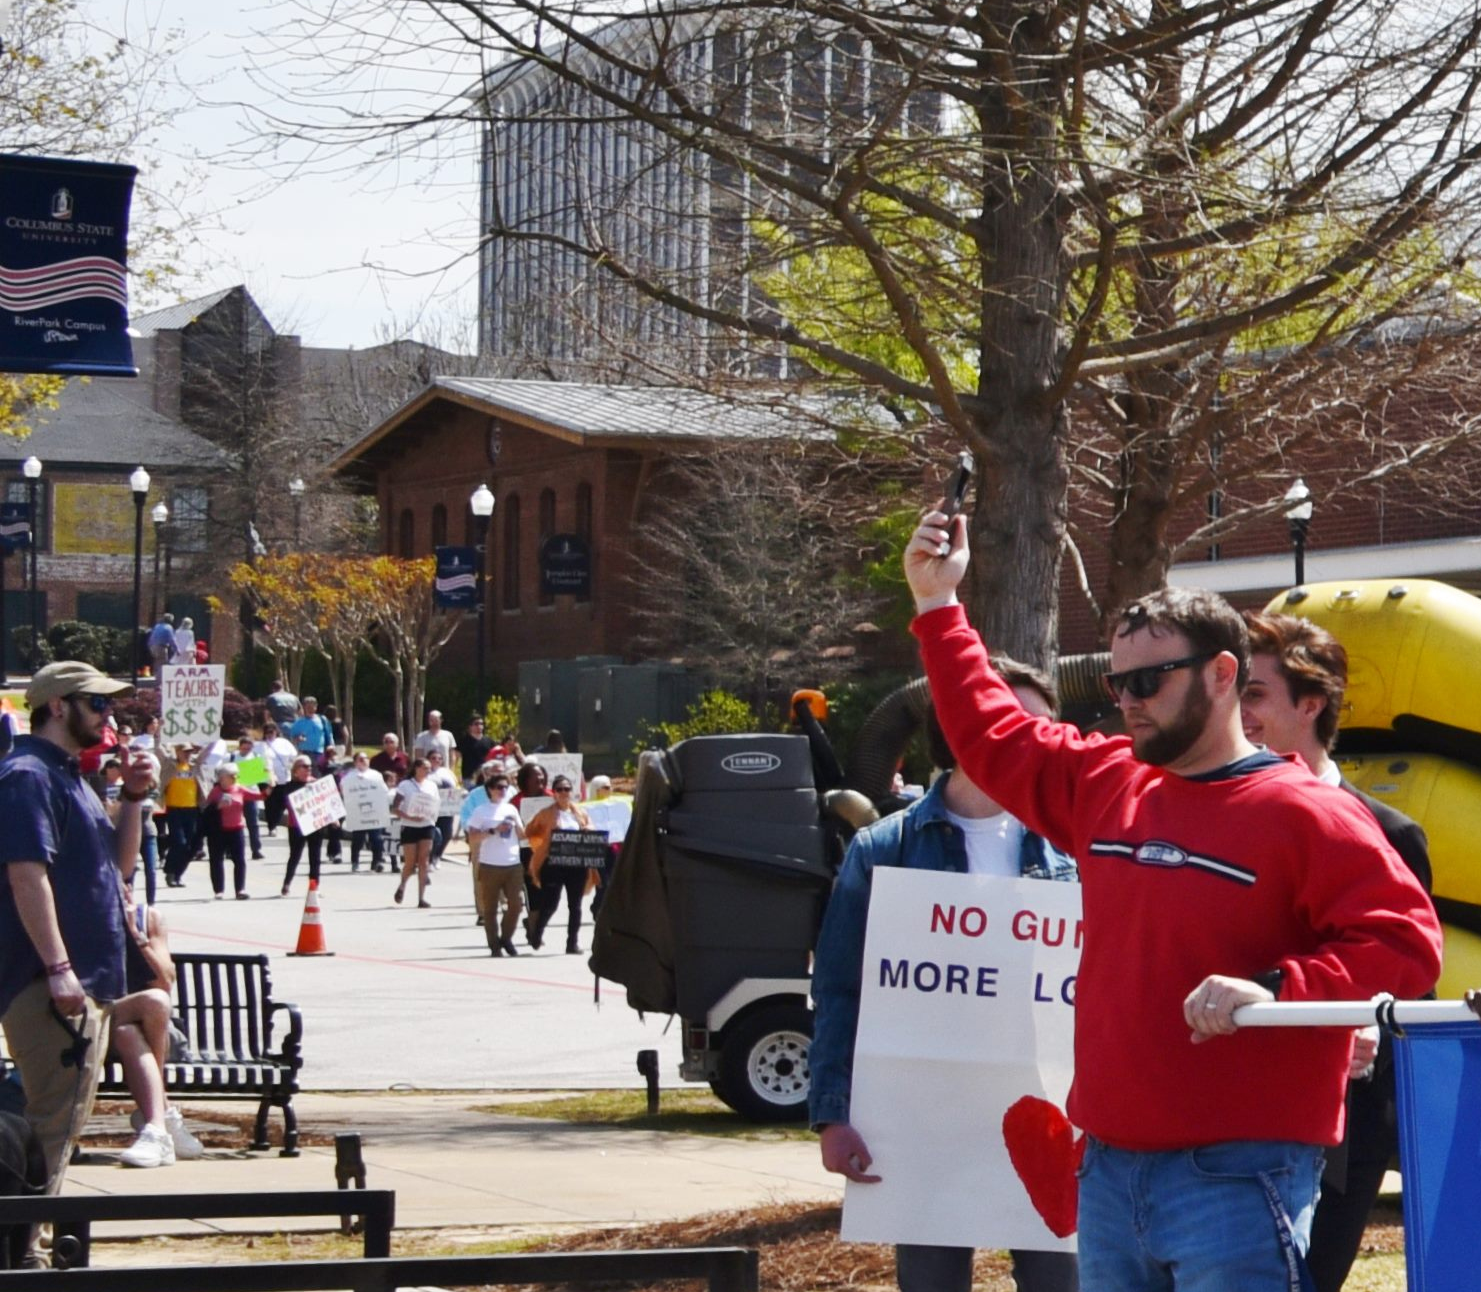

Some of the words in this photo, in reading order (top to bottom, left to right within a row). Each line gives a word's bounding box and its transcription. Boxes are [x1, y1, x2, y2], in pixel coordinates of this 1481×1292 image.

[5, 216, 75, 233] COLUMBUS
[77, 222, 115, 237] STATE
[22, 233, 98, 245] UNIVERSITY
[14, 316, 60, 329] RiverPark
[64, 319, 106, 332] Campus
[174, 667, 210, 678] ARM
[165, 679, 220, 699] TEACHERS
[172, 698, 207, 707] WITH
[930, 903, 988, 937] NO
[879, 958, 999, 997] MORE
